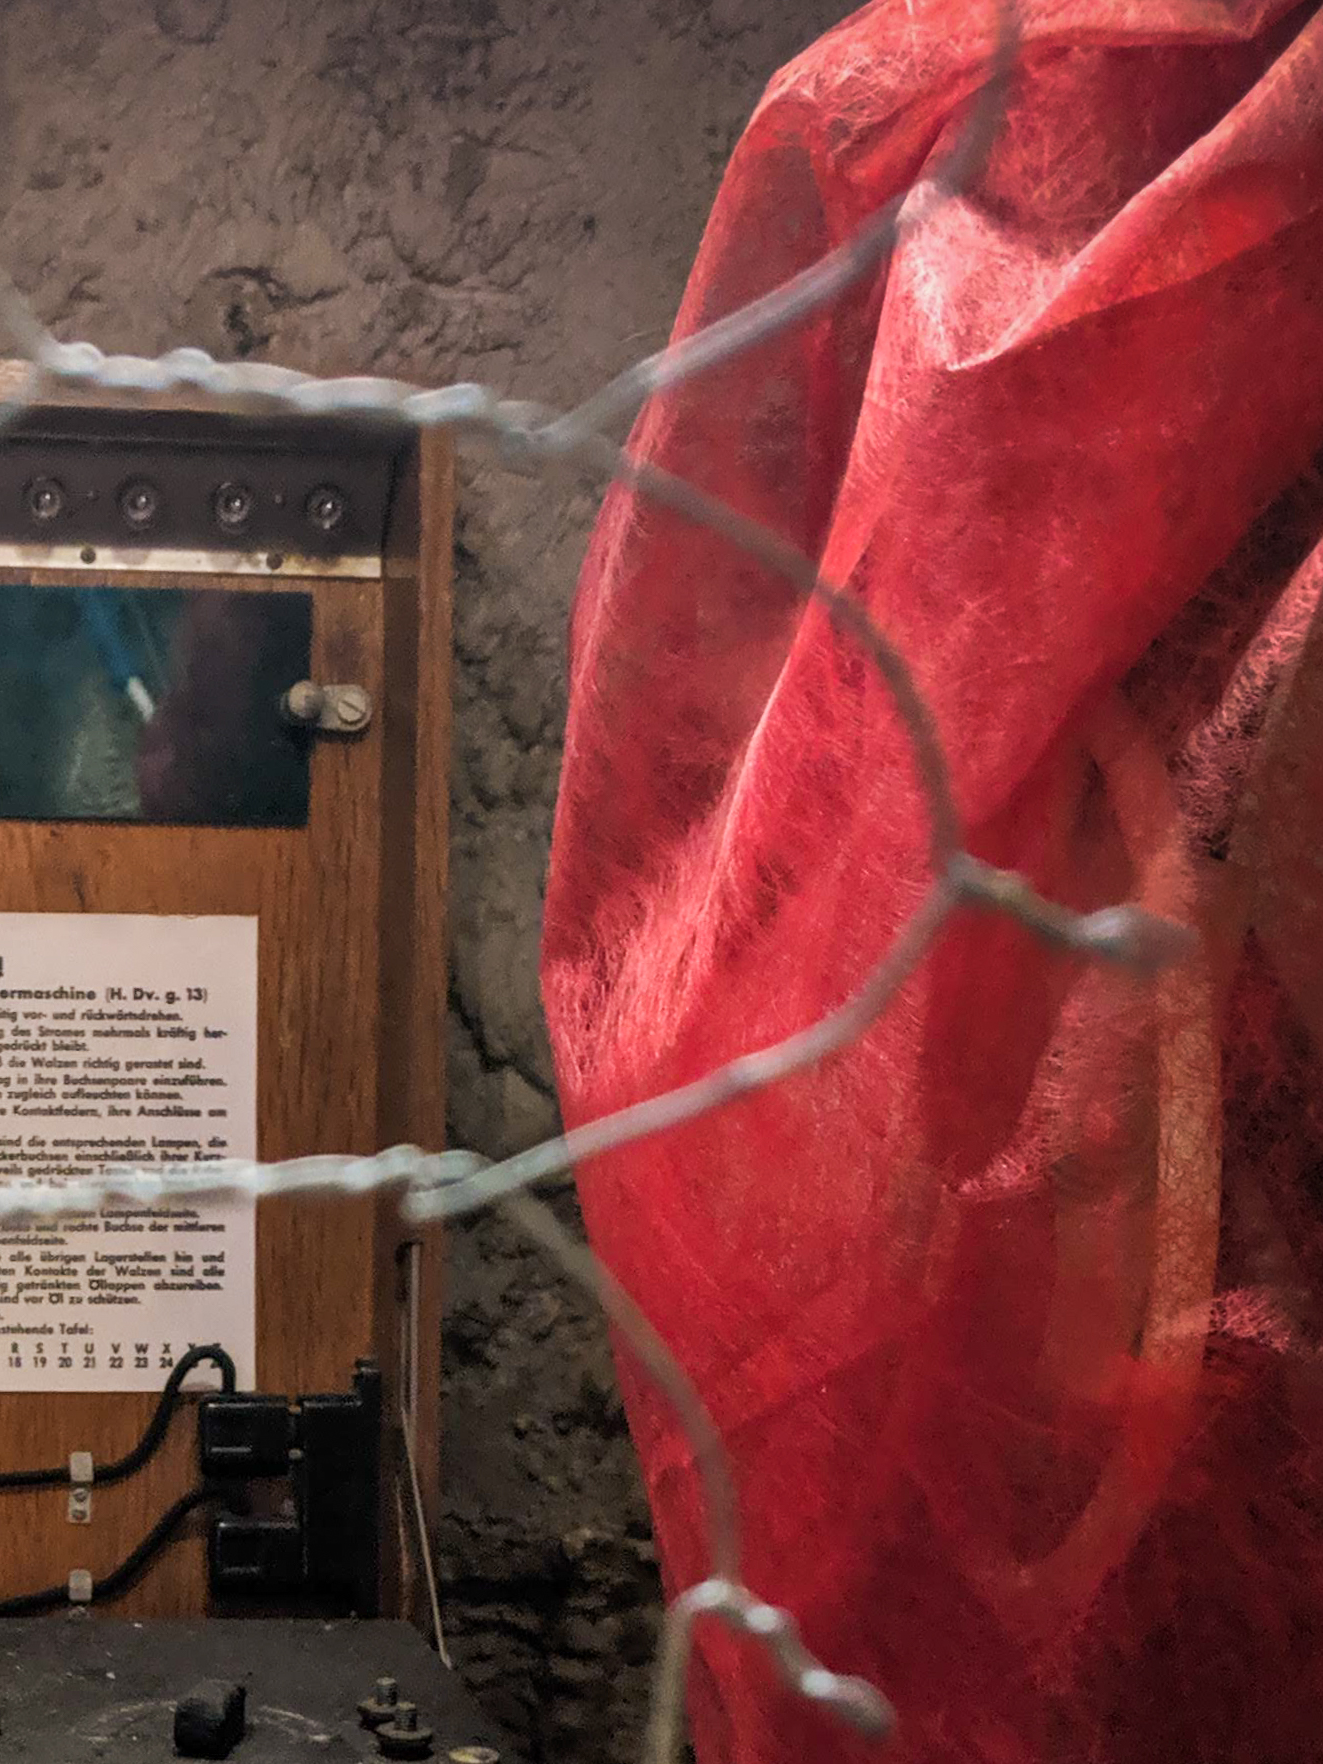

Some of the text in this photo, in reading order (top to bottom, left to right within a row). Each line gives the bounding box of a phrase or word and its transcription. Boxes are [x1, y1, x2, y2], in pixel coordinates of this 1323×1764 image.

[104, 986, 127, 1003] (H.
[132, 986, 160, 1000] Dv.
[164, 990, 181, 1003] g.
[186, 986, 208, 1004] 13)
[50, 1008, 77, 1020] und
[79, 1008, 184, 1021] rückwärtsdrehen.
[59, 1323, 93, 1334] Tafel:
[35, 1342, 43, 1353] S
[61, 1342, 68, 1353] T
[83, 1342, 94, 1353] U
[111, 1342, 120, 1353] V
[134, 1342, 149, 1353] W
[162, 1342, 171, 1353] X
[33, 1356, 47, 1368] 19
[58, 1356, 72, 1368] 20
[83, 1356, 96, 1368] 21
[109, 1356, 123, 1368] 22
[134, 1356, 148, 1368] 23
[159, 1356, 173, 1368] 24
